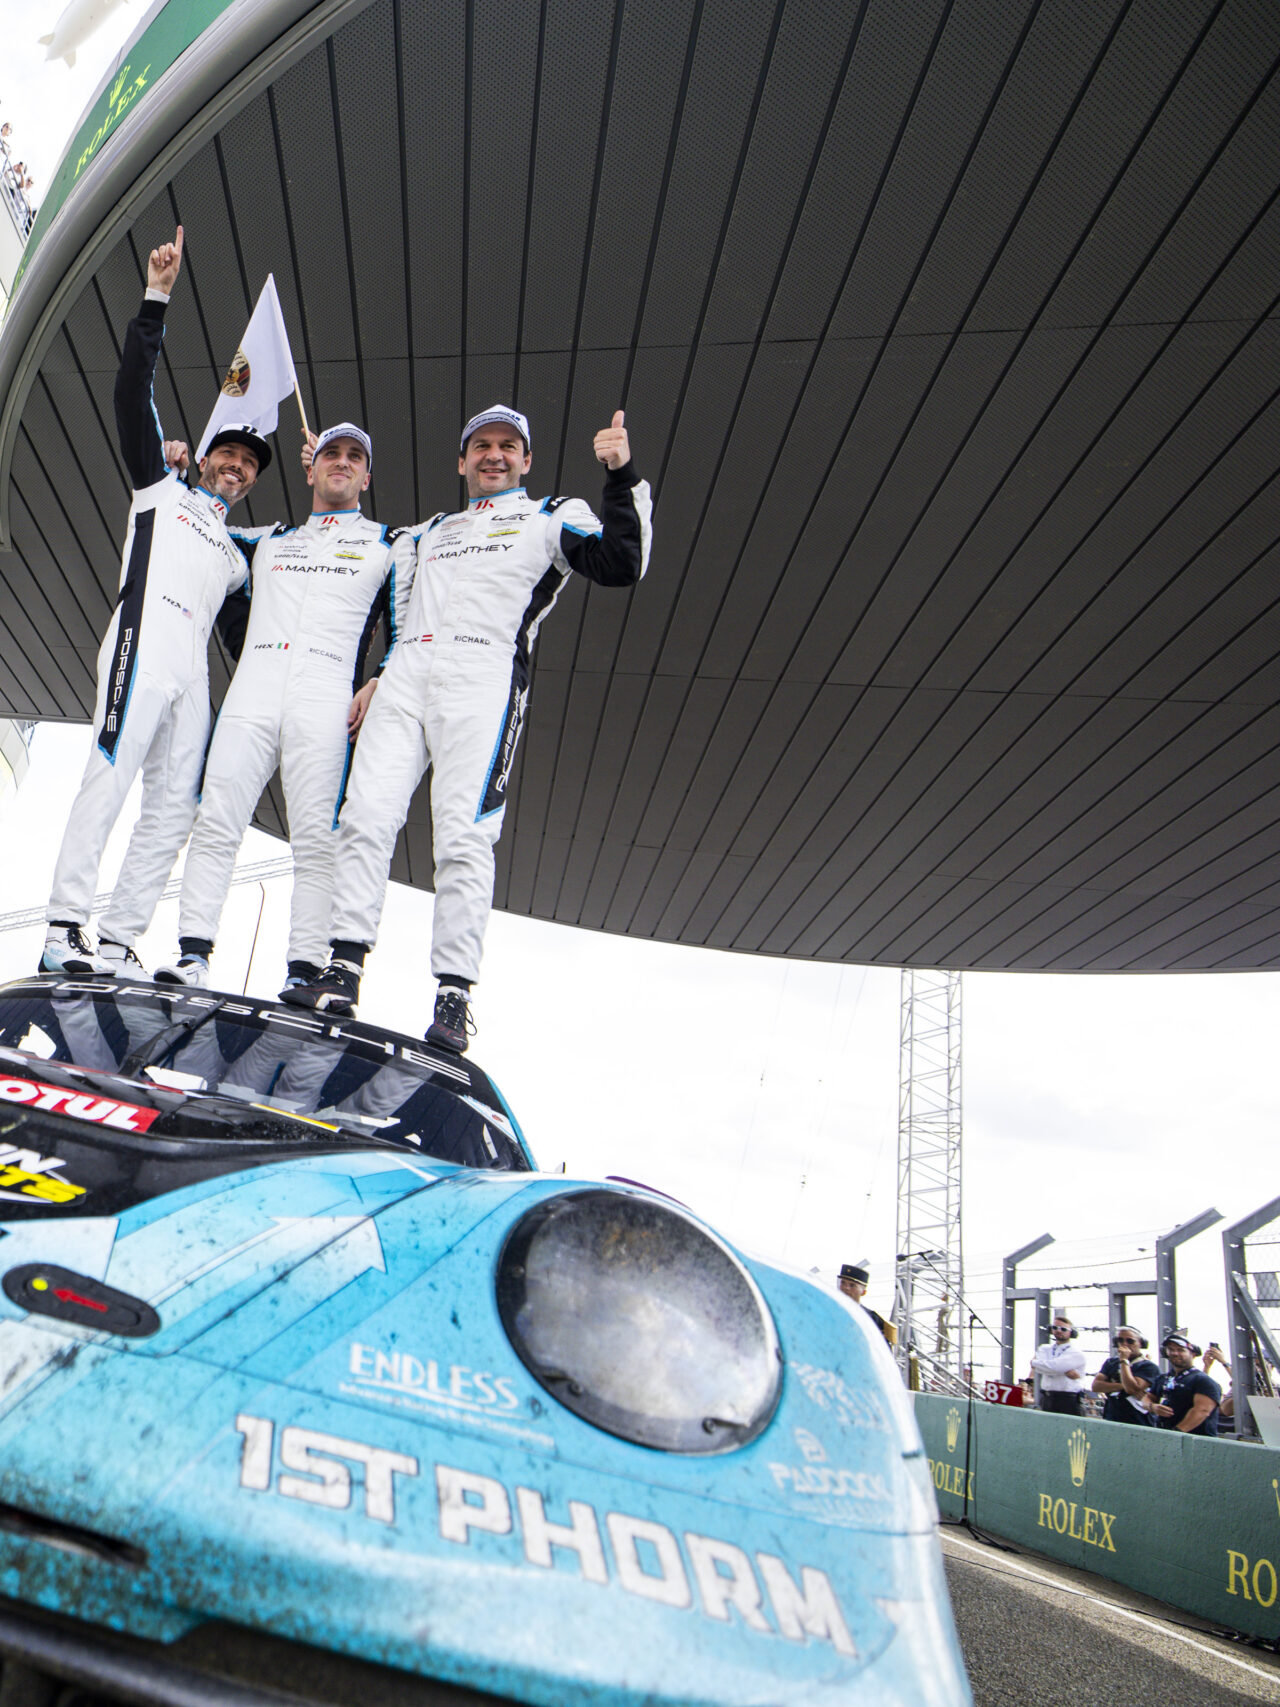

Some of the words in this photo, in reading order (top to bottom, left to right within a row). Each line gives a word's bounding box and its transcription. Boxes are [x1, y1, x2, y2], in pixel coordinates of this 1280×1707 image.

[73, 63, 152, 180] ROLEX
[285, 564, 360, 577] MANTHEY
[437, 543, 516, 560] MANTHEY
[308, 647, 343, 663] RICCARDO
[453, 635, 491, 646] RICHARD
[106, 627, 134, 733] PORSCHE
[6, 980, 472, 1086] PORSCHE
[348, 1342, 520, 1410] ENDLESS
[986, 1382, 1014, 1404] 87
[233, 1413, 420, 1526] 1ST
[434, 1463, 860, 1660] PHORM
[1037, 1493, 1117, 1553] ROLEX
